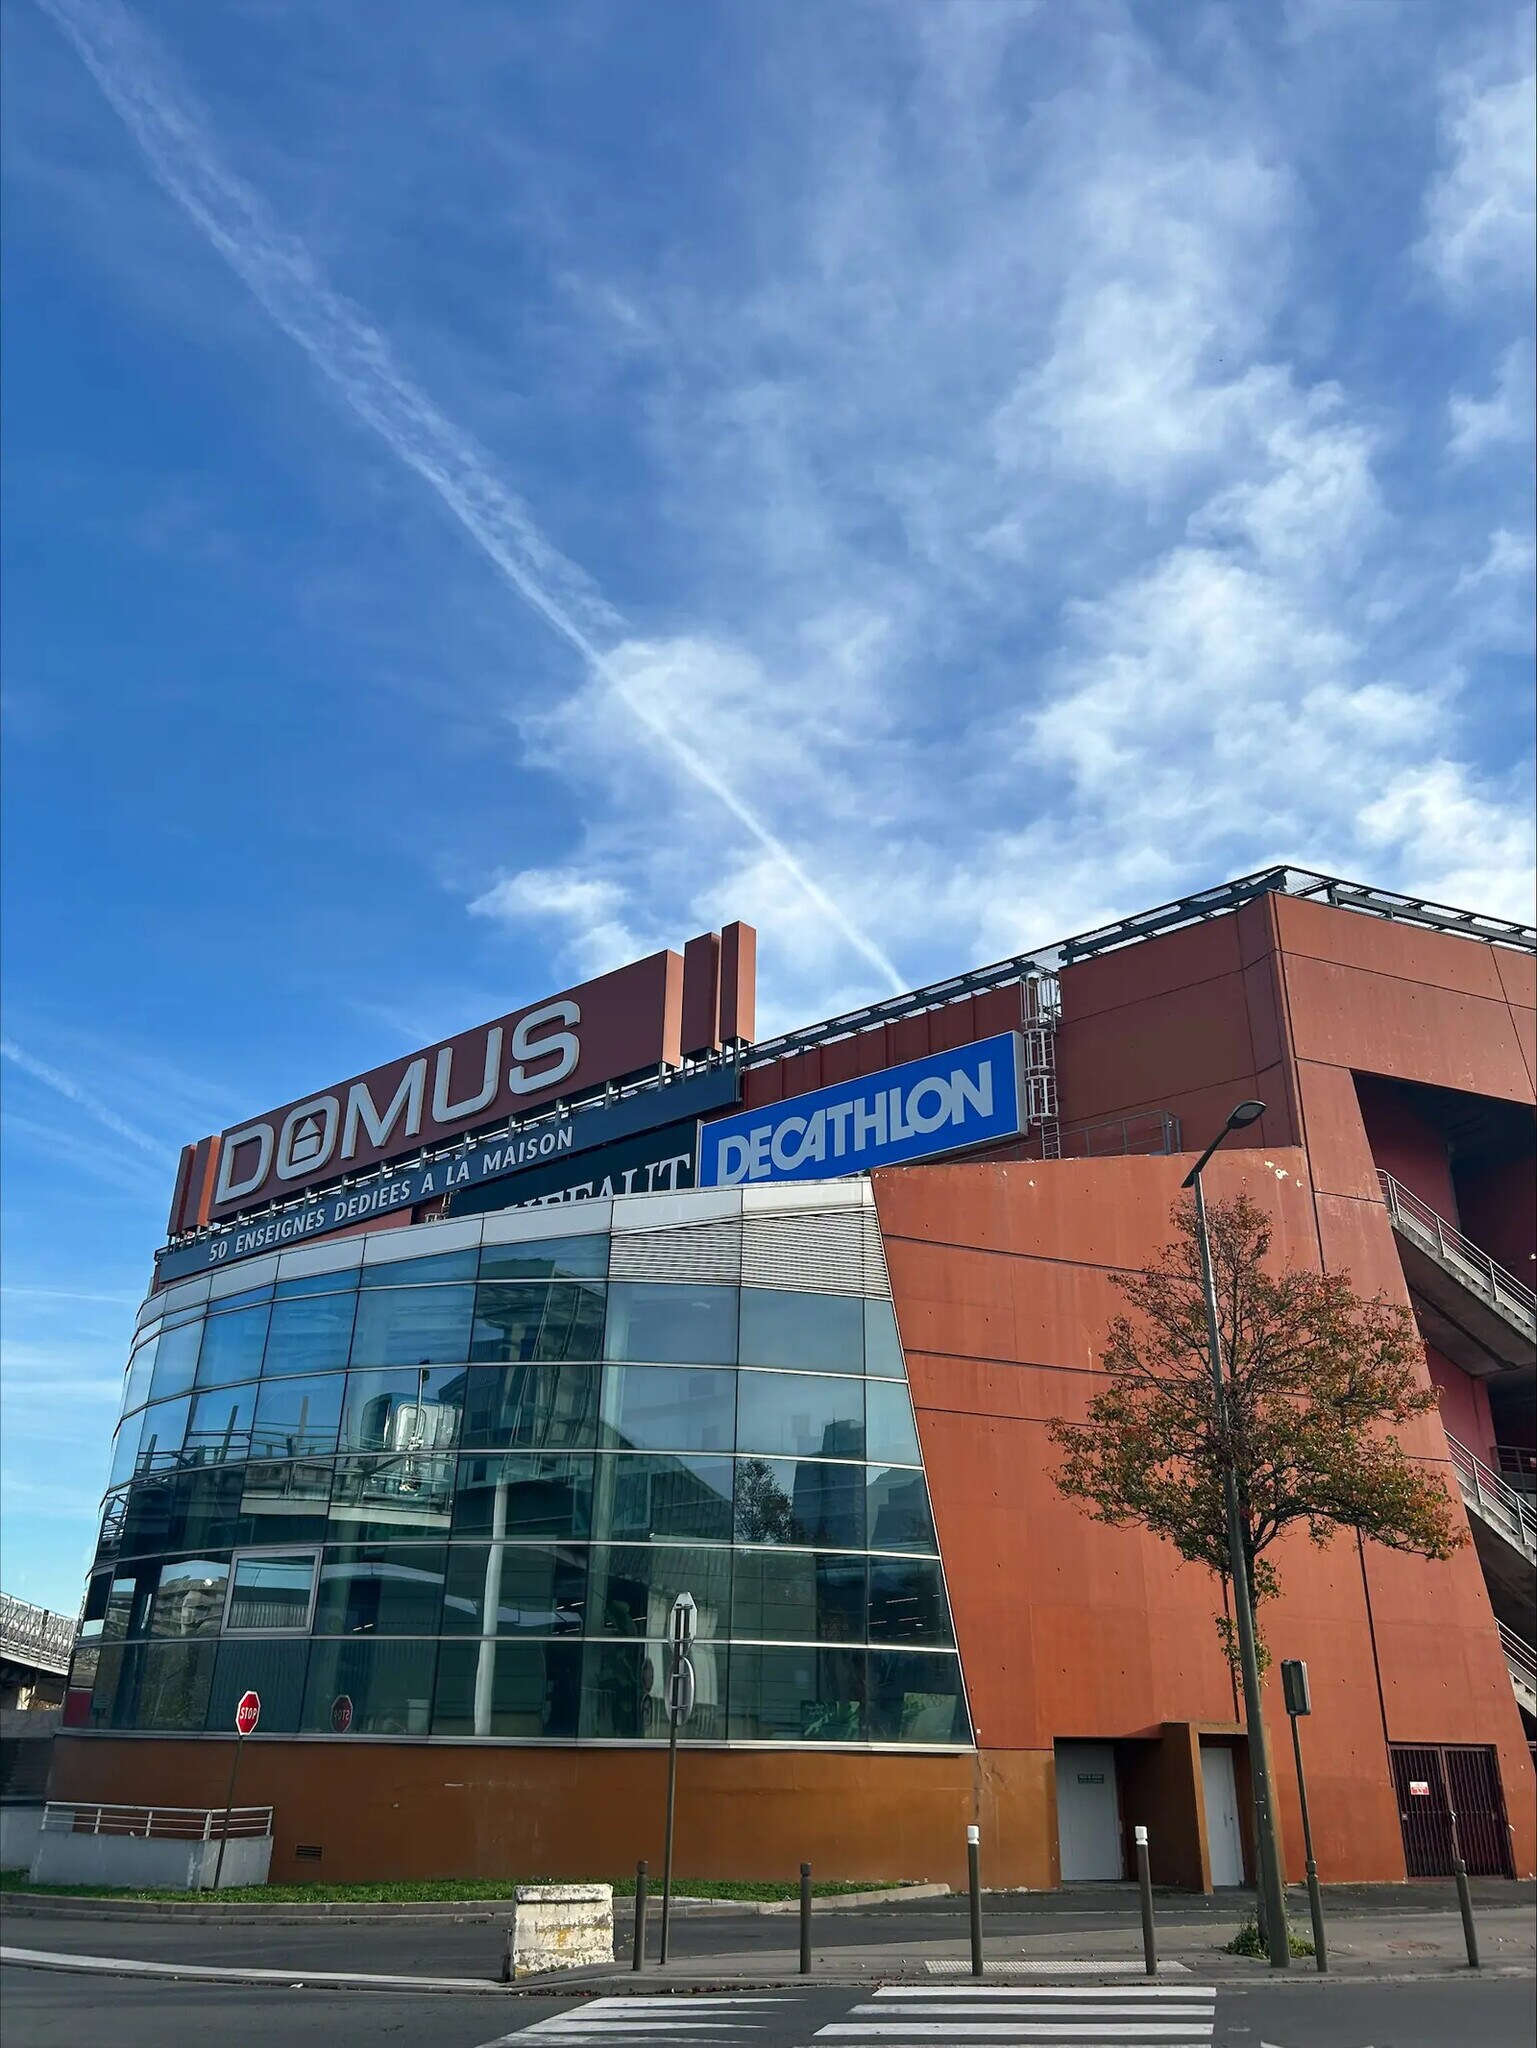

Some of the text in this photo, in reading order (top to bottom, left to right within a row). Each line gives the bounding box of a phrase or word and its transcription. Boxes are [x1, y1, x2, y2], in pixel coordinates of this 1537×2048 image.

[215, 999, 581, 1205] DOMUS
[717, 1060, 994, 1185] DECATHLON
[208, 1126, 573, 1262] 50 ENSEIGNES DEDIEES A LA MAISON
[239, 1707, 258, 1720] STOP
